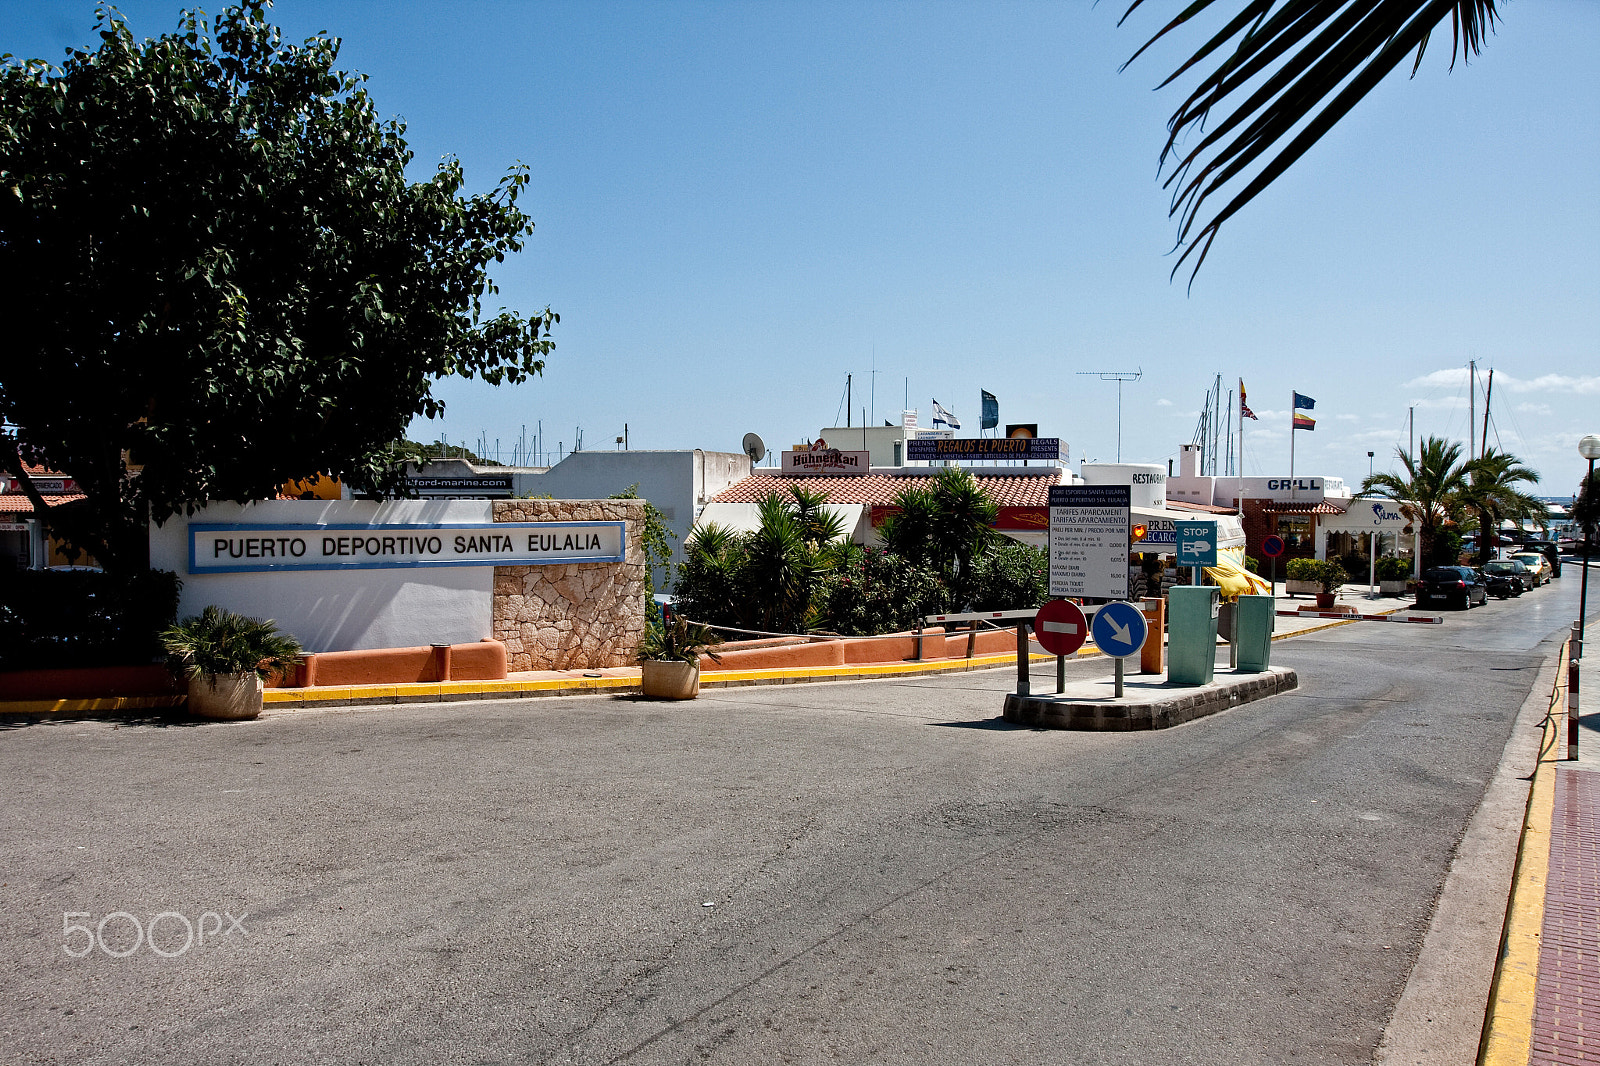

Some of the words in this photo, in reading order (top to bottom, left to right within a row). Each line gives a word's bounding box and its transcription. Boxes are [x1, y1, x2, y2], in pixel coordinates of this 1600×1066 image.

[937, 440, 976, 453] REGALOS
[978, 440, 988, 452] EL
[991, 440, 1027, 452] PUERTO
[1268, 480, 1320, 490] GRILL
[1183, 528, 1209, 537] STOP
[214, 537, 306, 558] PUERTO
[322, 536, 442, 556] DEPORTIVO
[454, 534, 514, 554] SANTA
[528, 533, 602, 552] EULALIA
